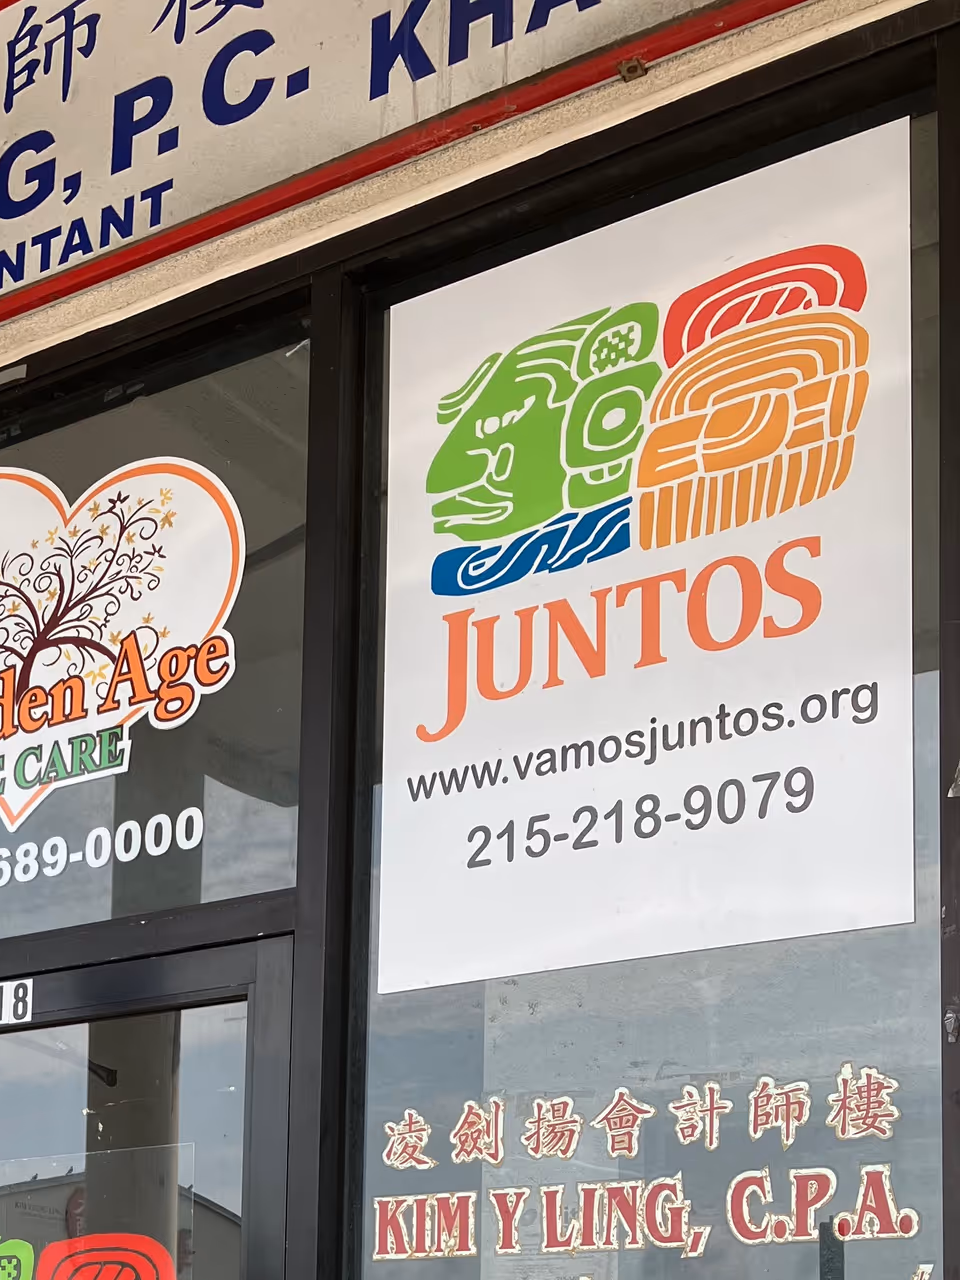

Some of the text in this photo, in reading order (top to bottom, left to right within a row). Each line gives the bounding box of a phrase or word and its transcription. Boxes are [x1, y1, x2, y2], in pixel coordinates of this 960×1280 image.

[111, 29, 311, 175] P.C.
[100, 631, 230, 722] Age
[415, 535, 822, 743] JUNTOS
[13, 726, 126, 788] CARE
[407, 681, 879, 802] www.vamosjuntos.org
[466, 766, 814, 869] 215-218-9079
[383, 1062, 900, 1170] 凌劍揚會計師樓
[373, 1163, 919, 1260] KIM Y LING, C.P.A.
